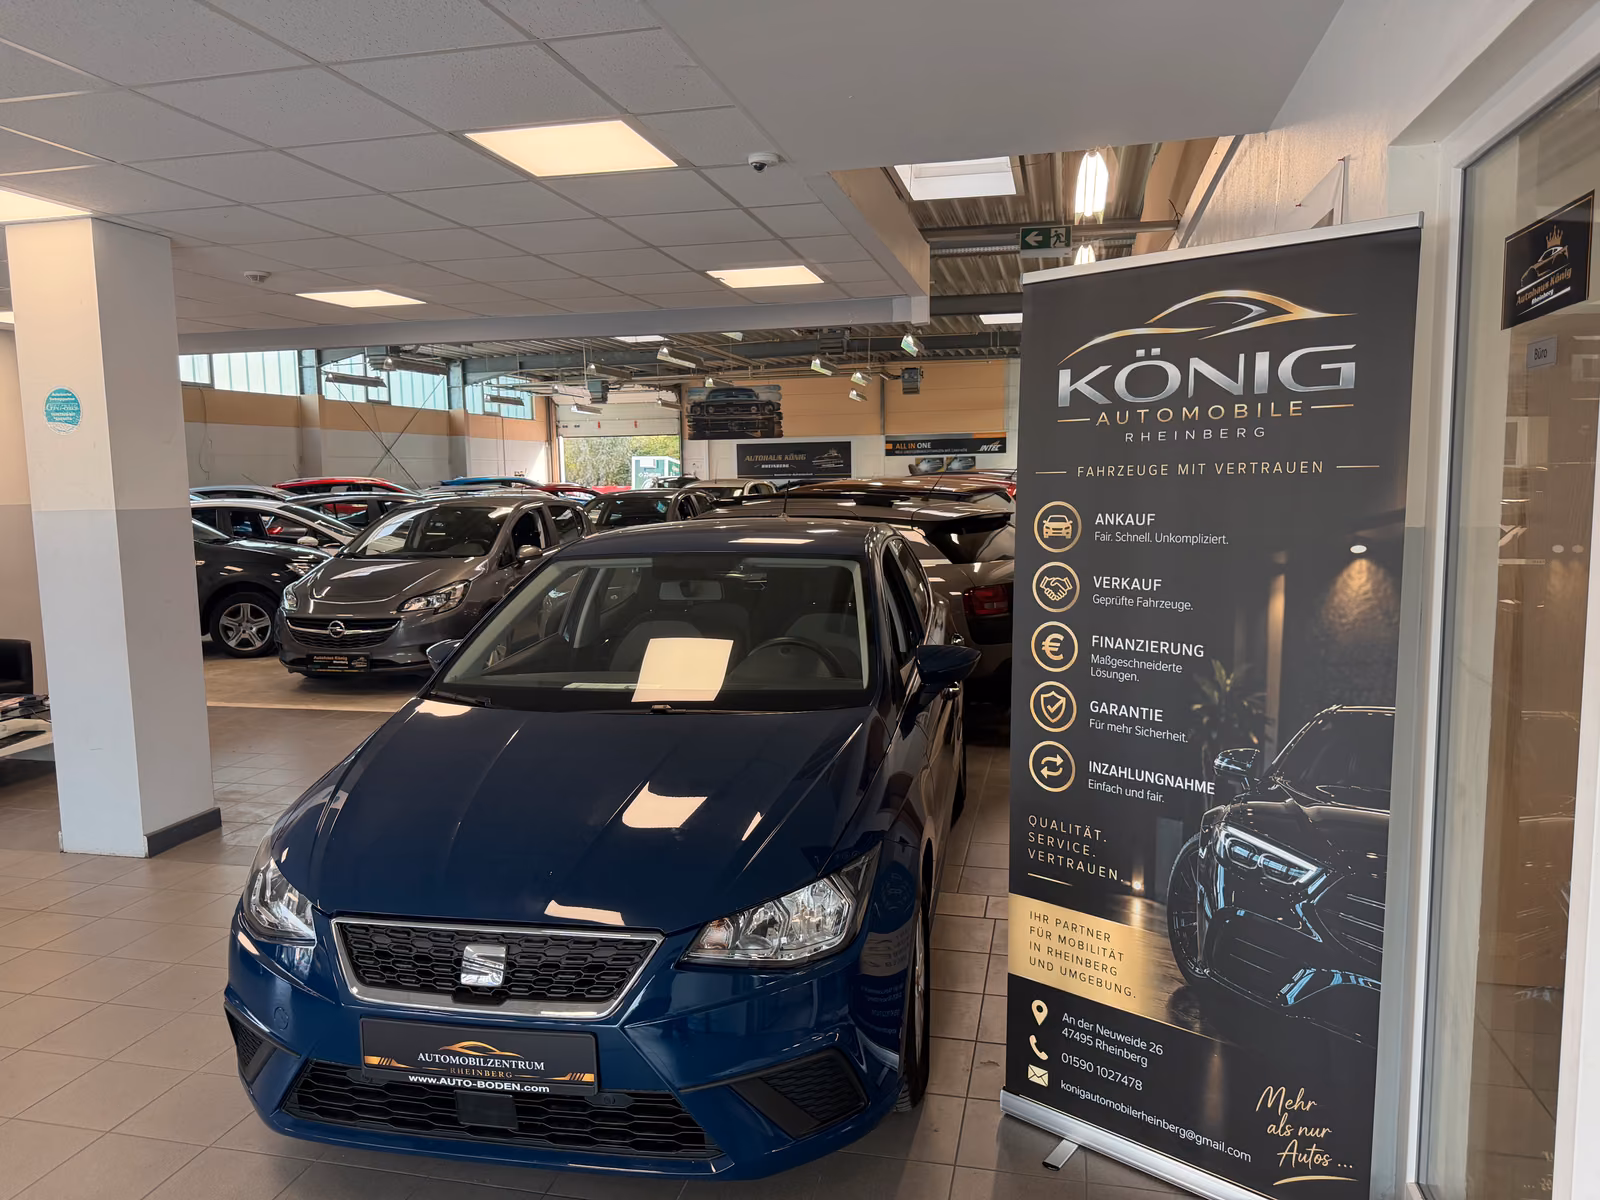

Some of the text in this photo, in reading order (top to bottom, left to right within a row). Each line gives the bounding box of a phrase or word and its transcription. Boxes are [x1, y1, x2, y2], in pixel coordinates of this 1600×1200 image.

[1534, 347, 1548, 361] Büro
[1057, 343, 1357, 408] KÖNIG
[1095, 400, 1304, 426] AUTOMOBILE
[1125, 426, 1267, 443] RHEINBERG
[1076, 461, 1324, 477] FAHRZEUGE MIT VERTRAUEN
[1094, 513, 1156, 526] ANKAUF
[1094, 531, 1229, 546] Fair. Schnell. Unkompliziert.
[1093, 576, 1162, 591] VERKAUF
[1092, 594, 1193, 612] Geprüfte Fahrzeuge.
[1091, 635, 1205, 658] FINANZIERUNG
[1090, 667, 1140, 682] Lösungen.
[1091, 653, 1183, 673] Maßgeschneiderte
[1089, 700, 1163, 722] GARANTIE
[1089, 718, 1189, 743] Für mehr Sicherheit.
[1088, 760, 1216, 795] INZAHLUNGNAHME
[1088, 779, 1165, 803] Einfach und fair.
[1028, 814, 1107, 843] QUALITÄT.
[1028, 831, 1096, 858] SERVICE.
[1027, 847, 1124, 882] VERTRAUEN.
[1029, 910, 1111, 943] IHR PARTNER
[1029, 926, 1124, 962] FÜR MOBILITÄT
[1029, 940, 1118, 977] IN RHEINBERG
[1029, 956, 1136, 999] UND UMGEBUNG.
[1062, 1012, 1164, 1056] An der Neuweide 26
[1061, 1027, 1148, 1068] 47495 Rheinberg
[417, 1052, 545, 1071] AUTOMOBILZENTRUM
[450, 1067, 513, 1079] RHEINBERG
[1061, 1052, 1143, 1091] 01590 1027478
[408, 1074, 550, 1093] www.AUTO-BODEN.com
[1255, 1085, 1318, 1116] Mehr
[1060, 1079, 1252, 1163] konigautomobilerheinberg@gmail.com
[1267, 1112, 1333, 1138] als nur
